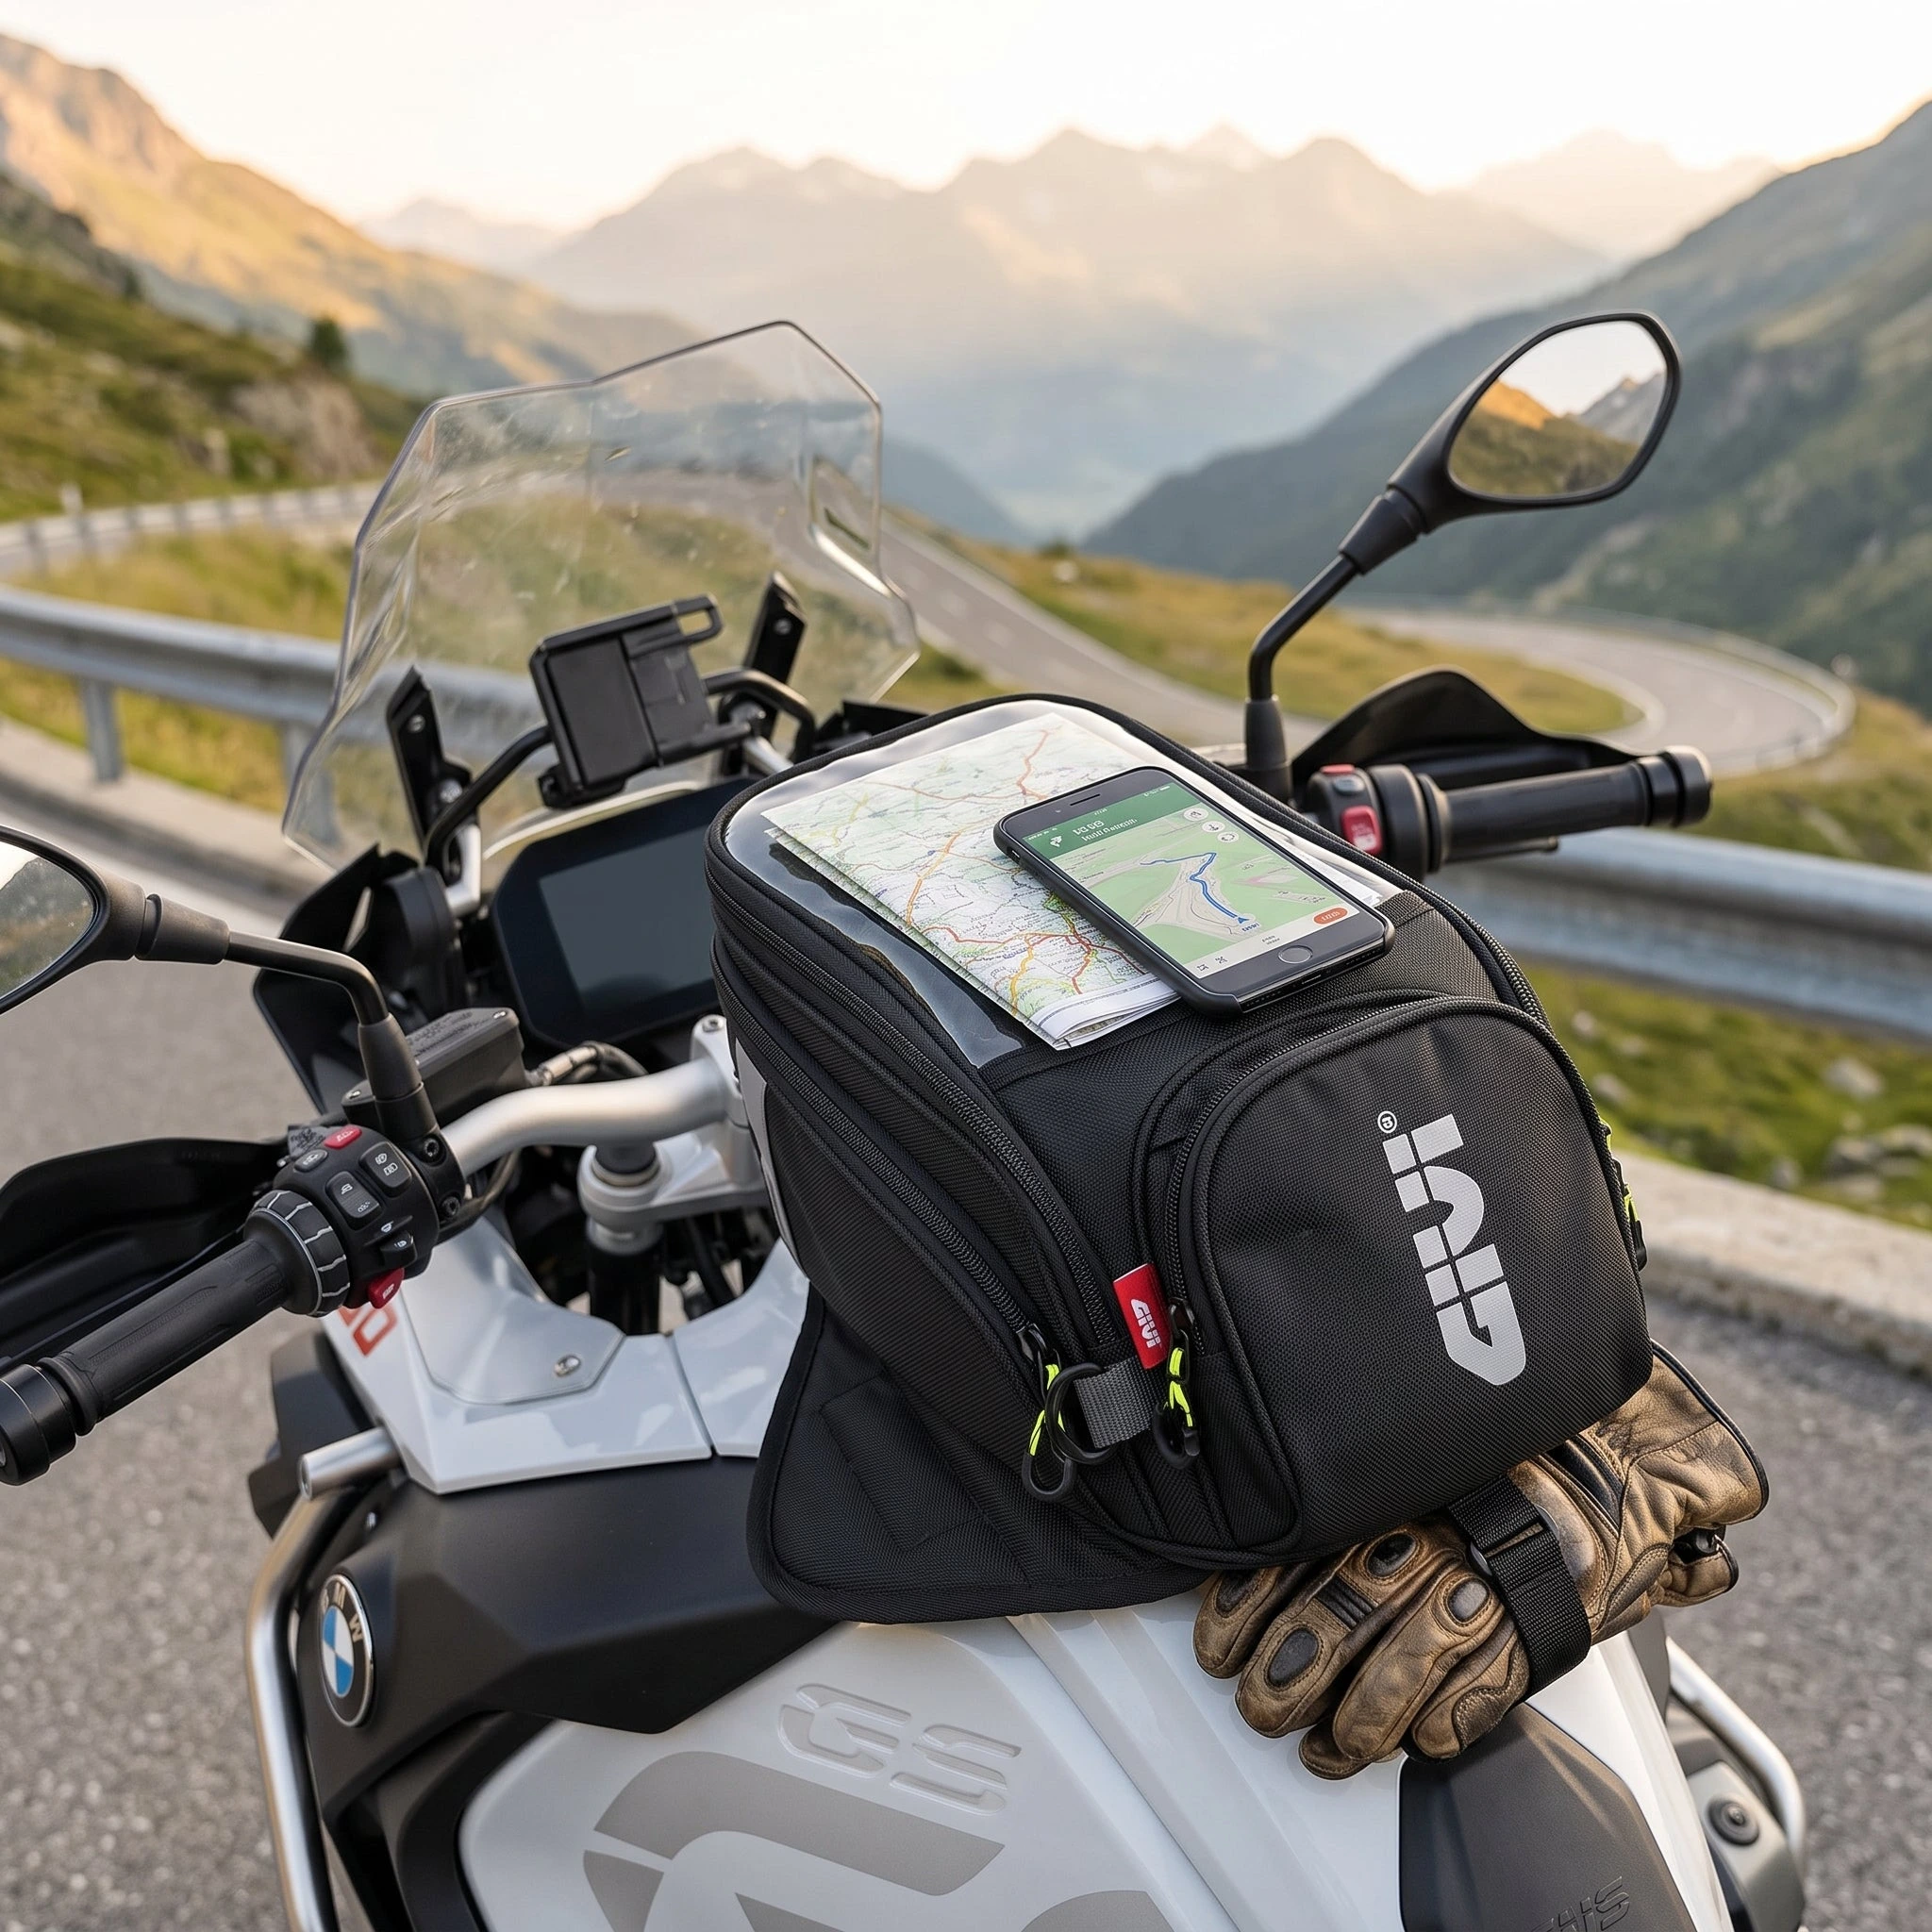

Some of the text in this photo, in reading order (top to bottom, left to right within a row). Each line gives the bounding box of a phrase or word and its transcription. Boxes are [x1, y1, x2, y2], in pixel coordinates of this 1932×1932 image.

[1130, 1298, 1162, 1349] GIVI
[319, 1581, 363, 1644] BMW
[777, 1683, 1023, 1816] GS
